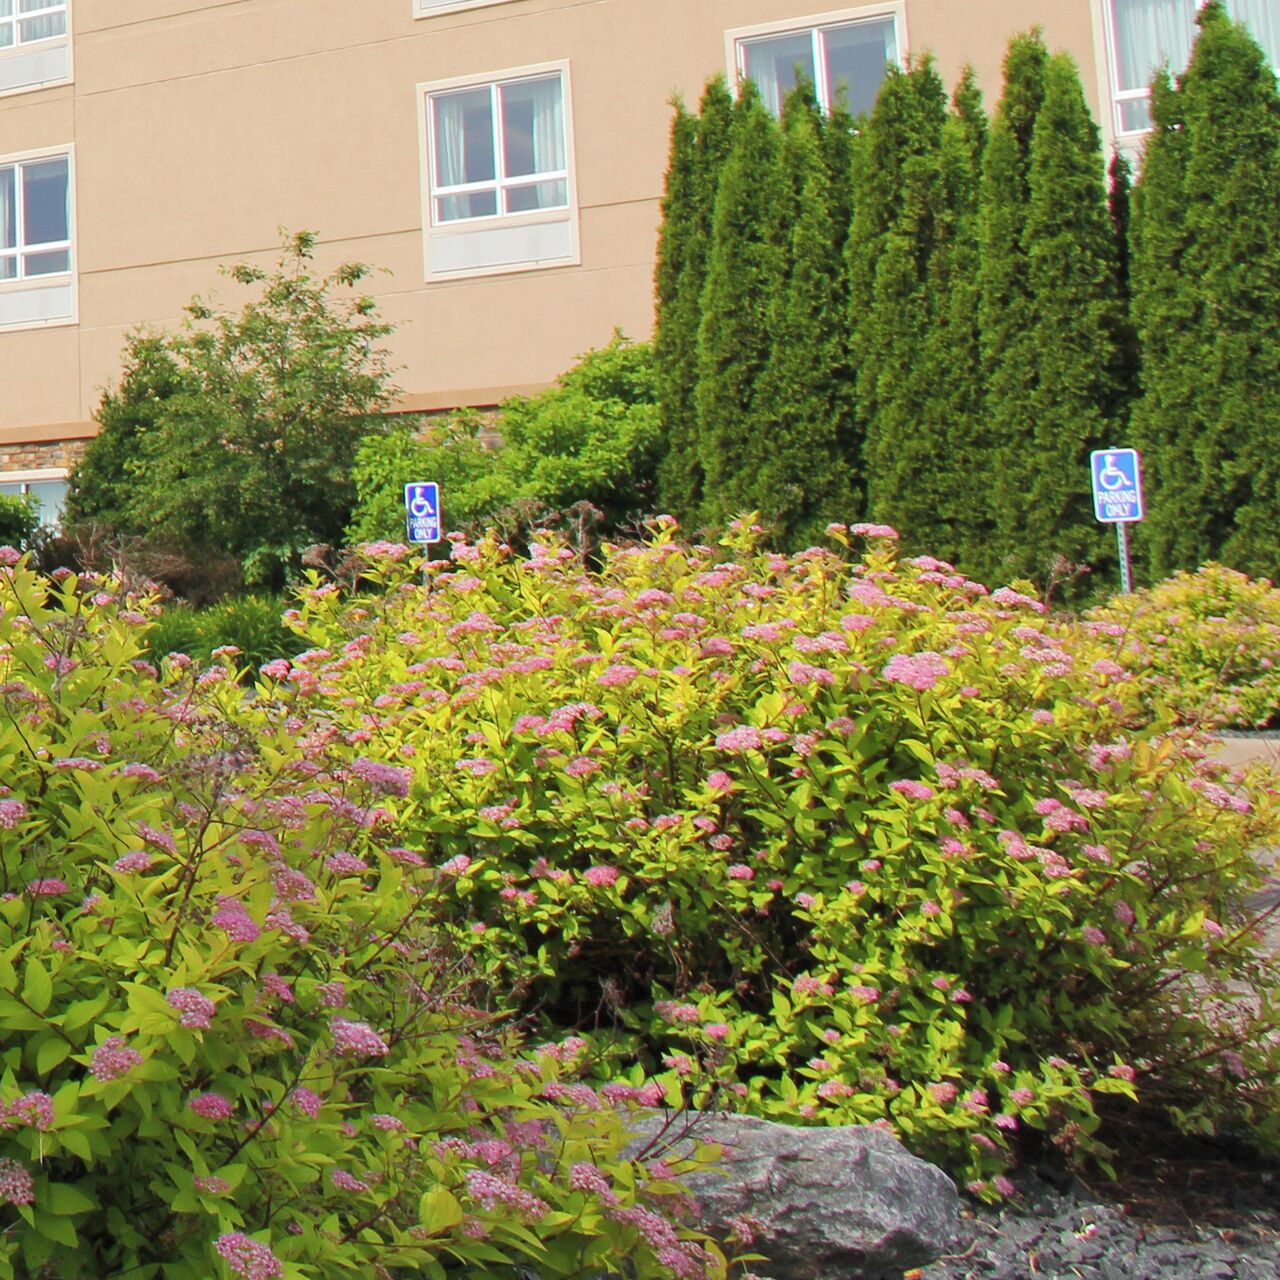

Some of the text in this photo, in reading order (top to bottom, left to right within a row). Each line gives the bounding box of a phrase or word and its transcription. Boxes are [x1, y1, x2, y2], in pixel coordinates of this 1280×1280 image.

[1098, 490, 1137, 504] PARKING
[1106, 504, 1131, 517] ONLY
[409, 517, 437, 528] PARKING
[414, 528, 433, 539] ONLY
